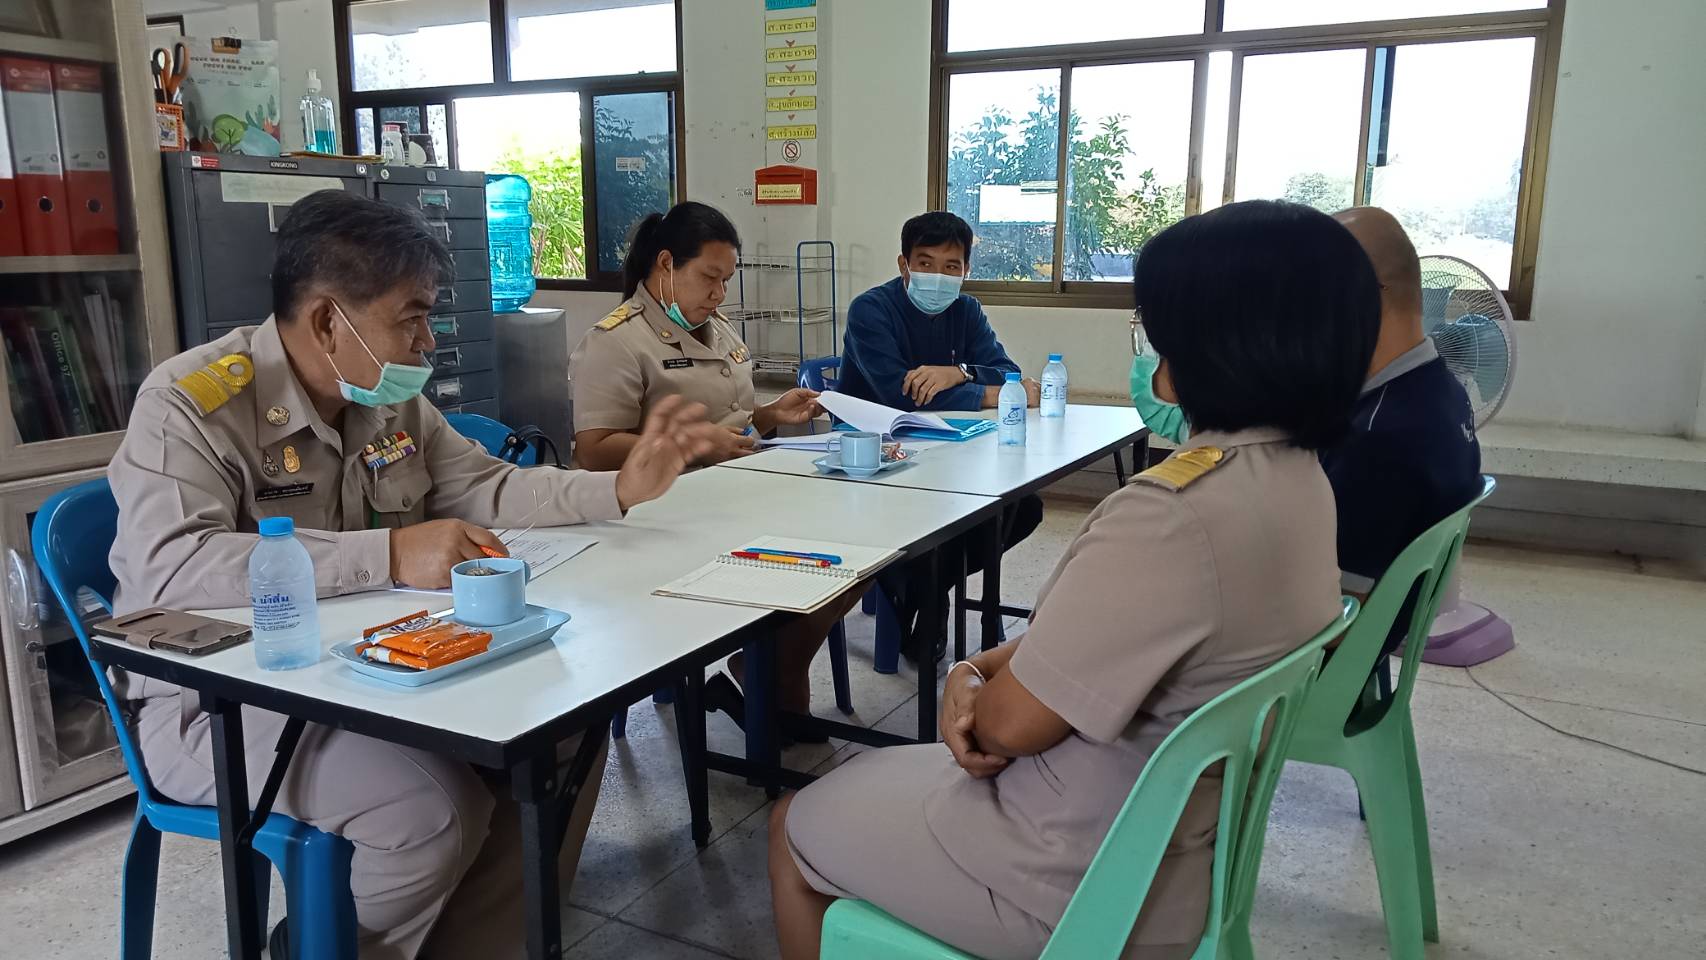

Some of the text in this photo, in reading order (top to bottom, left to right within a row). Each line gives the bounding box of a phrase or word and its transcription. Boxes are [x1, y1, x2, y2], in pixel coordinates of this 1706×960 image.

[768, 21, 815, 31] ส.สะสาง
[768, 48, 815, 59] ส.สะอาด
[51, 332, 65, 363] Office
